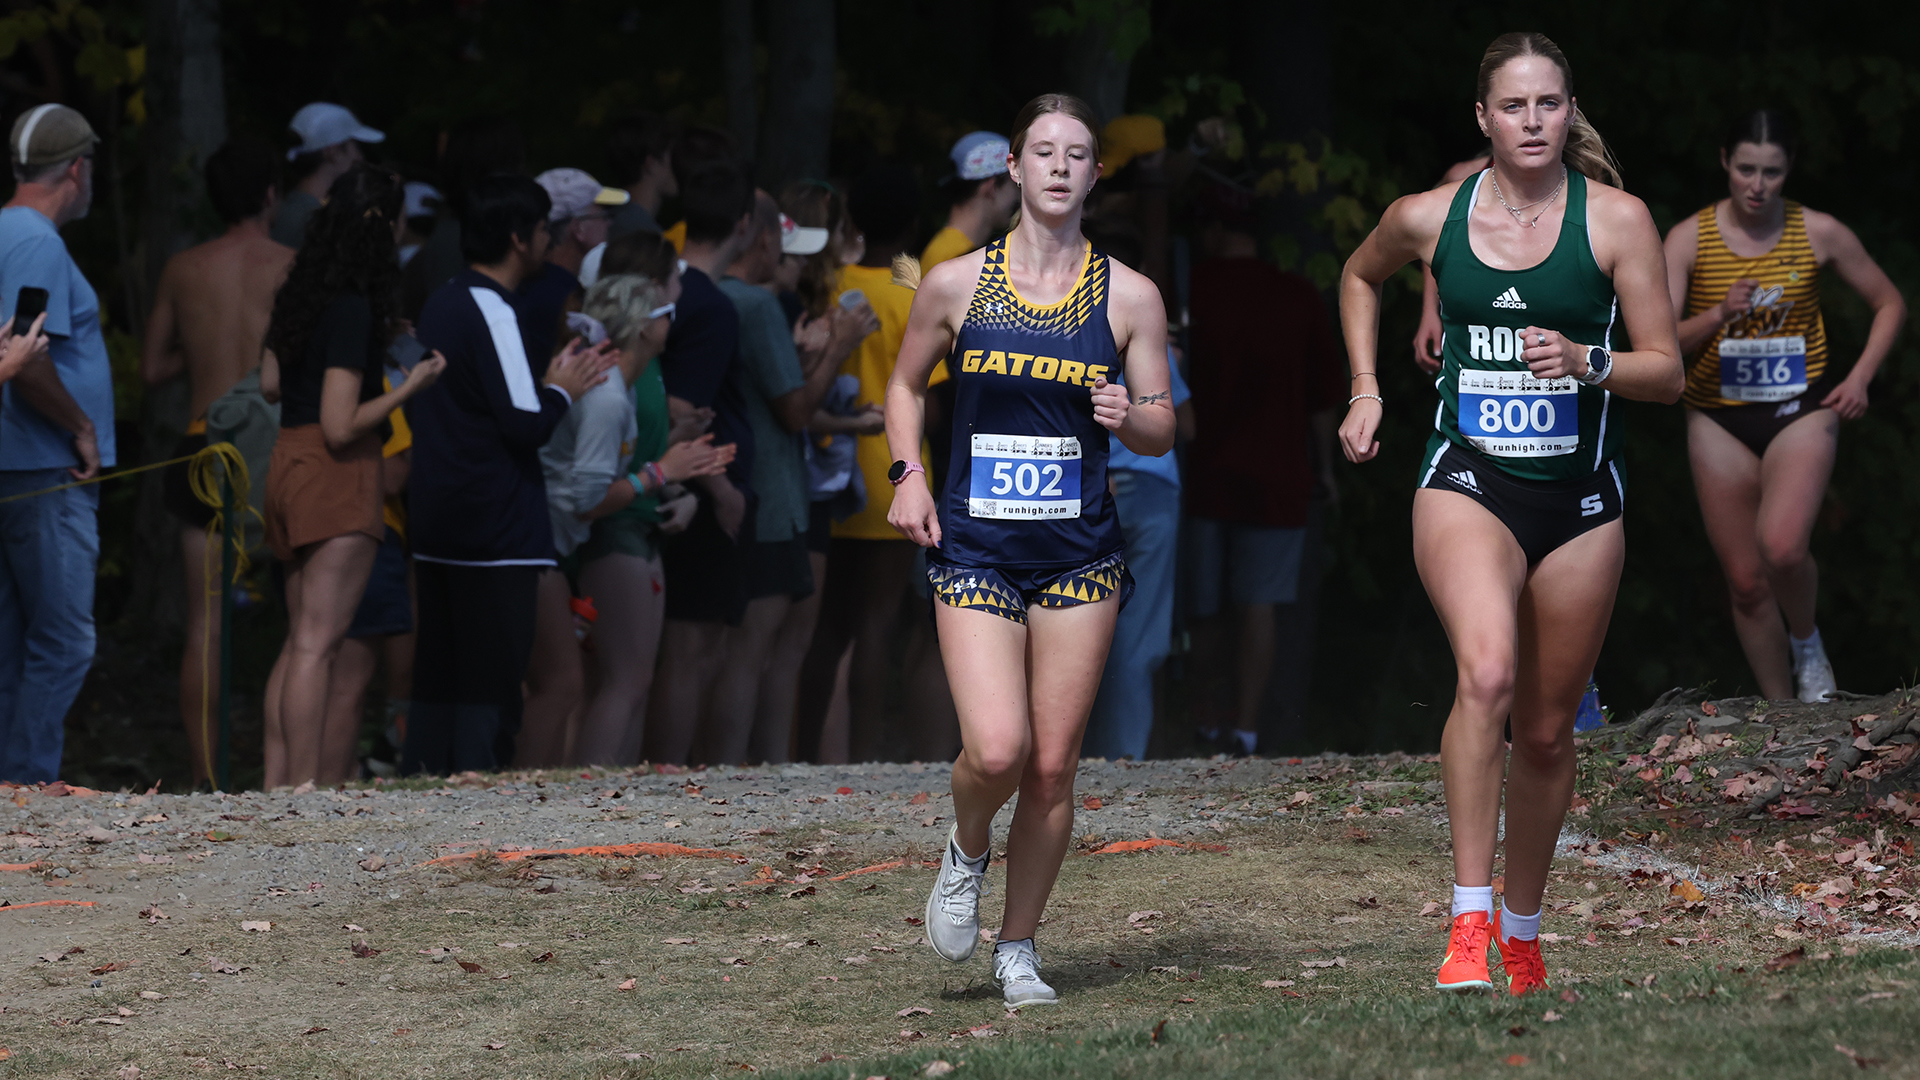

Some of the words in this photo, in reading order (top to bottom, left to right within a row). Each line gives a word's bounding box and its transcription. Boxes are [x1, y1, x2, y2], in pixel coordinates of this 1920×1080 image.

[1492, 300, 1528, 310] adidas
[961, 349, 1110, 388] GATORS
[1736, 357, 1792, 385] 516
[1478, 398, 1556, 434] 800
[1493, 443, 1563, 453] runhigh.com
[990, 461, 1064, 497] 502
[1003, 506, 1067, 516] runhigh.com
[1580, 492, 1604, 517] S
